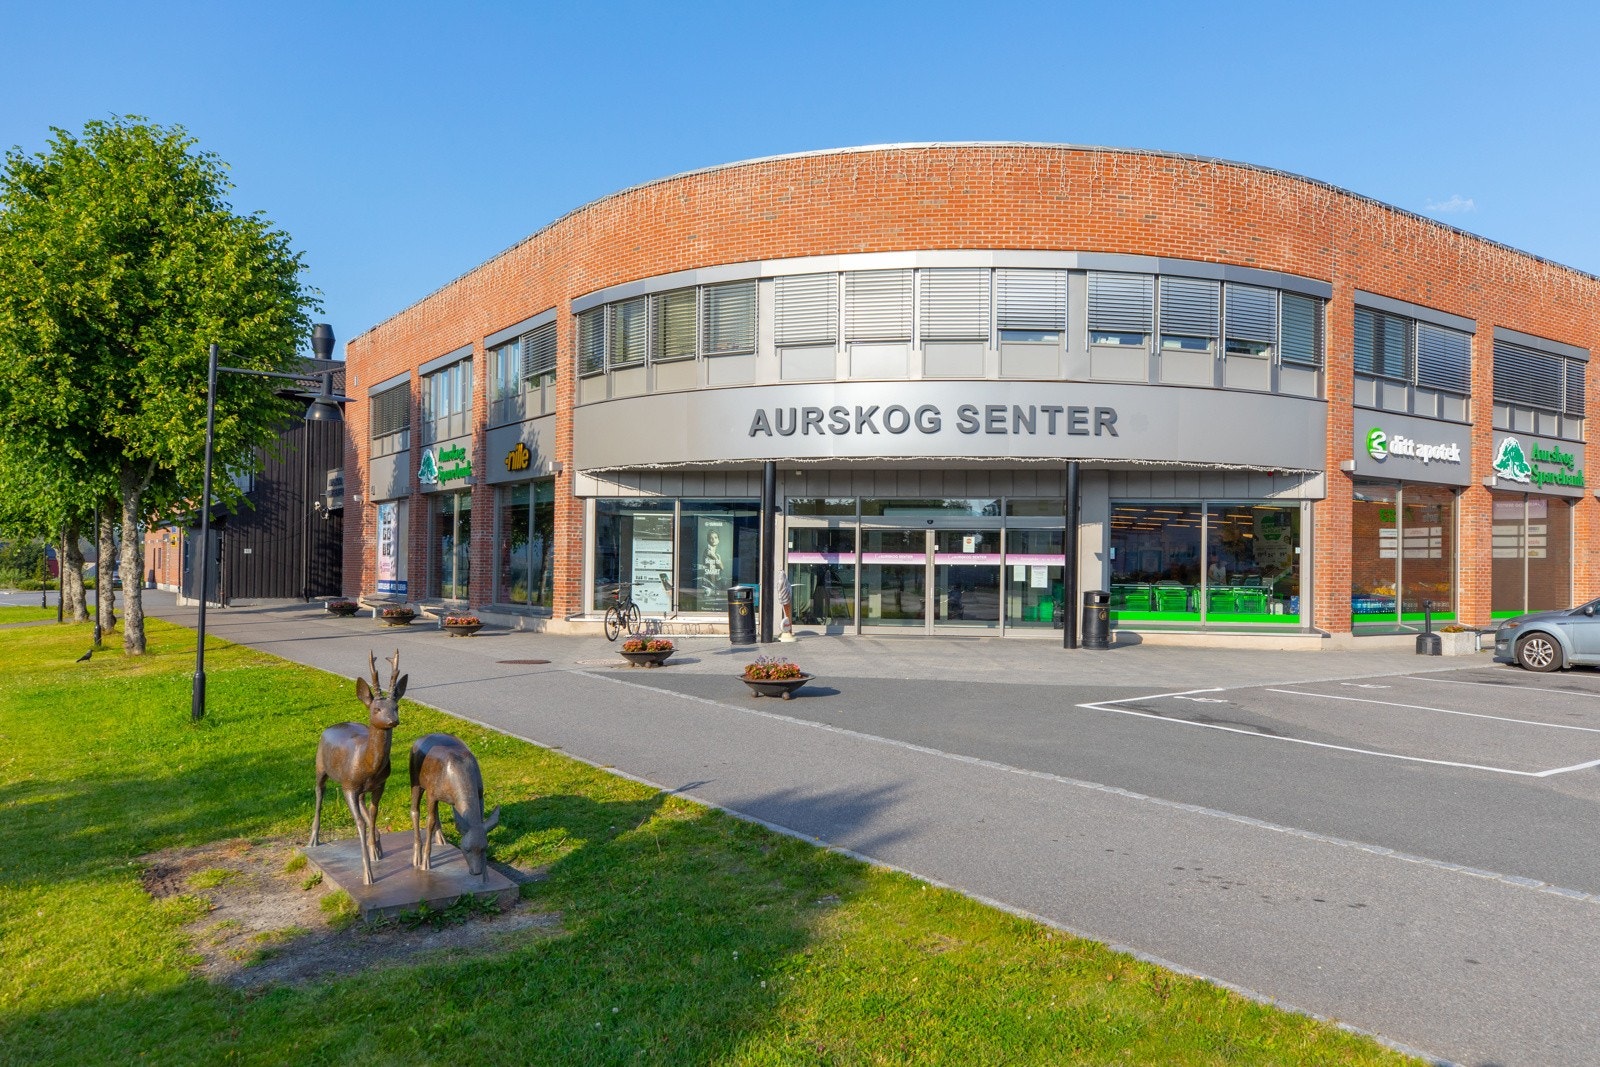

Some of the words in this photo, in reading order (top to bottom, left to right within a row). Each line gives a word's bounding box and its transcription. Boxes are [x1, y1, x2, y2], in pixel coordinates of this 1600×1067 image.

[748, 404, 942, 437] AURSKOG
[956, 404, 1119, 437] SENTER
[1390, 435, 1415, 456] ditt
[1416, 443, 1461, 463] apotek
[1531, 441, 1575, 471] Aurskog
[1530, 464, 1585, 489] Sparebank
